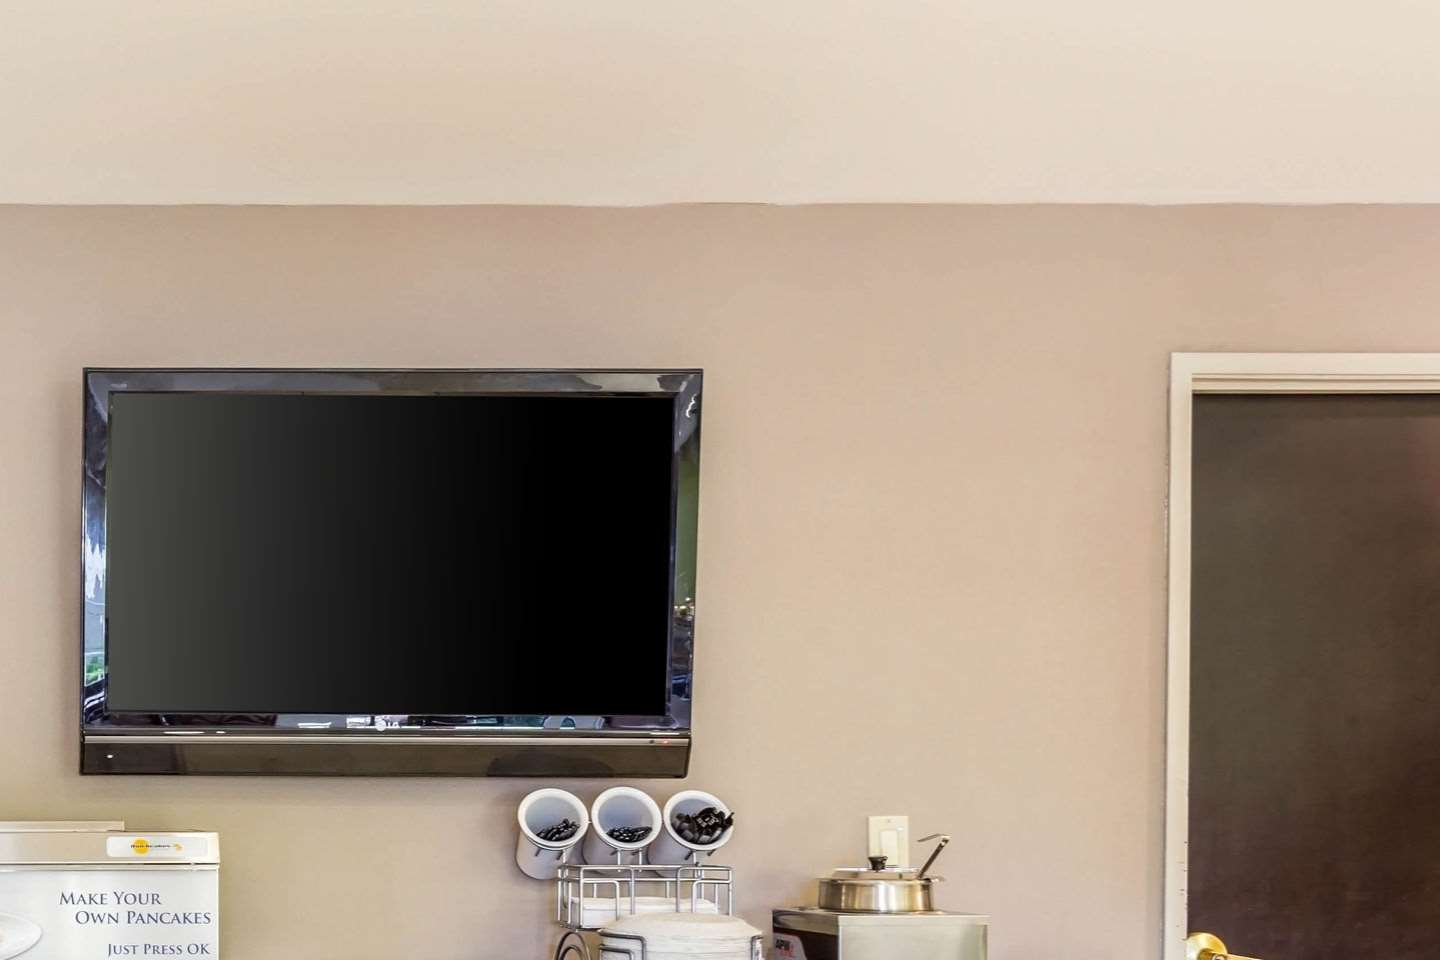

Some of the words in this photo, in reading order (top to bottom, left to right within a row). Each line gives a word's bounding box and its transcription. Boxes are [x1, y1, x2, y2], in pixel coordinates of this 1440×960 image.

[59, 891, 108, 905] MAKE
[113, 891, 162, 905] YOUR
[75, 911, 119, 925] OWN
[127, 911, 212, 925] PANCAKES
[108, 944, 139, 957] JUST
[144, 944, 183, 955] PRESS
[187, 944, 211, 955] OK
